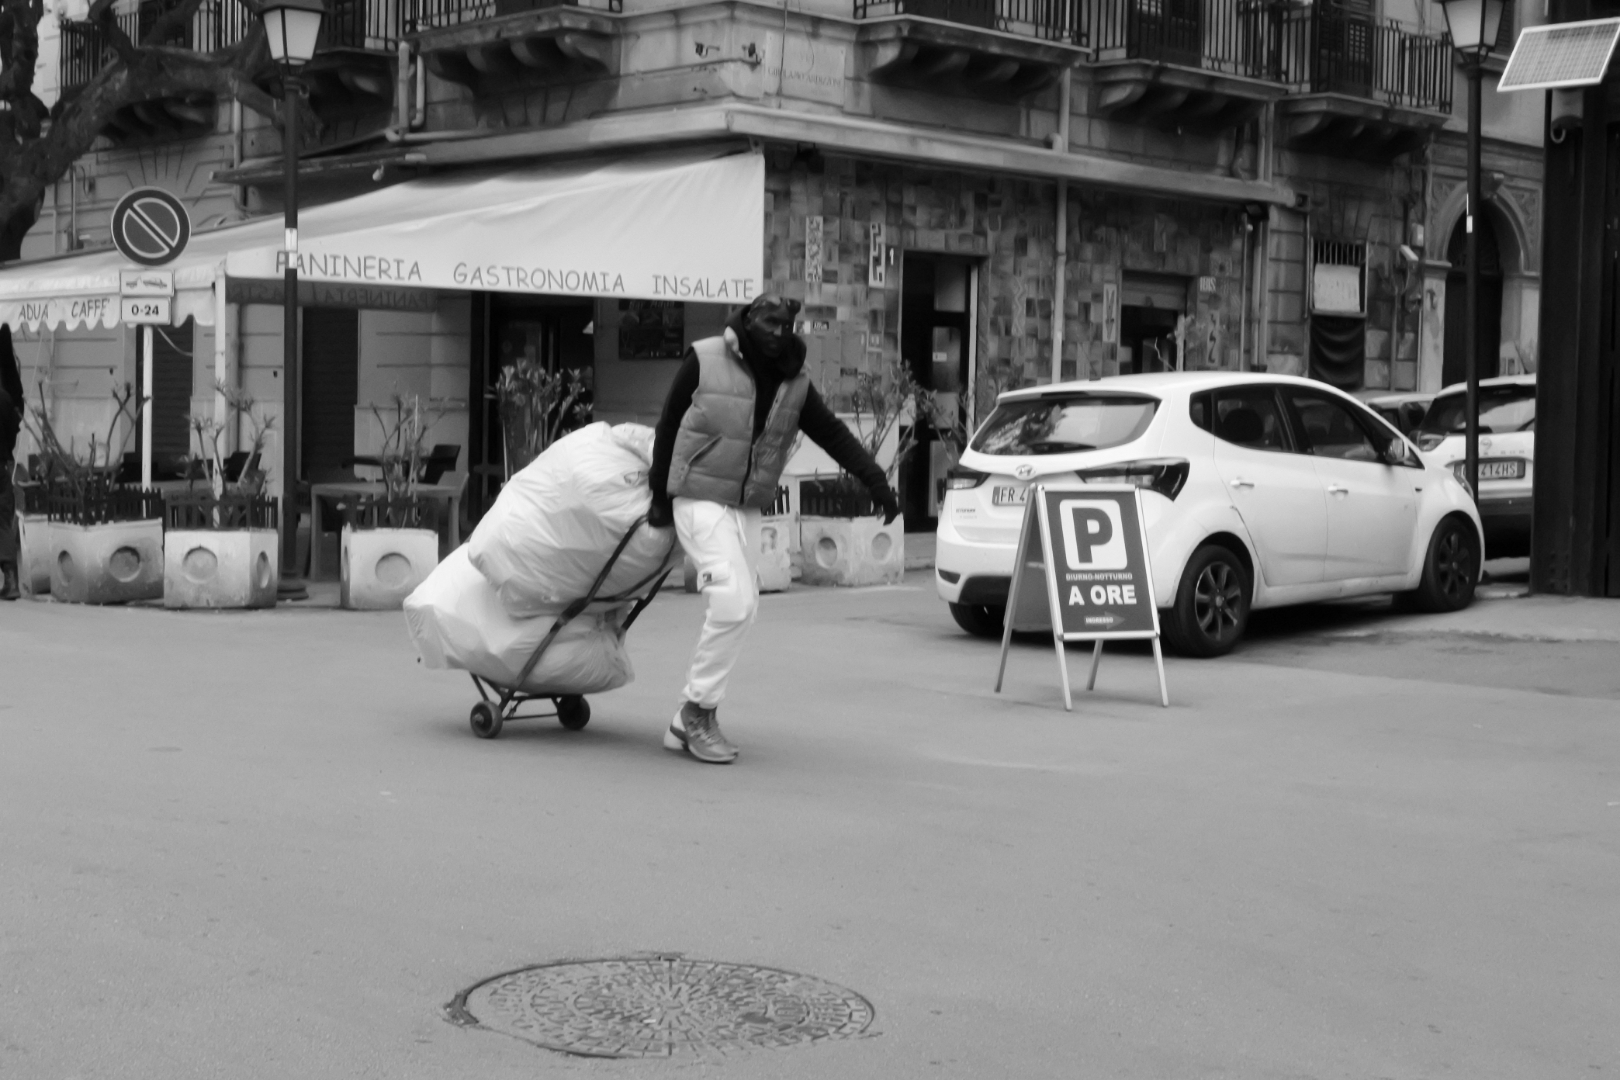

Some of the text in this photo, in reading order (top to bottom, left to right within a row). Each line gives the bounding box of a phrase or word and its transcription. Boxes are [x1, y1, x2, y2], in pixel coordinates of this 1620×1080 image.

[275, 250, 754, 300] PANINERIA GASTRONOMIA INSALATE
[18, 303, 49, 321] ADUA
[131, 304, 159, 316] 0-24
[1072, 507, 1113, 563] P
[1068, 584, 1138, 606] A ORE
